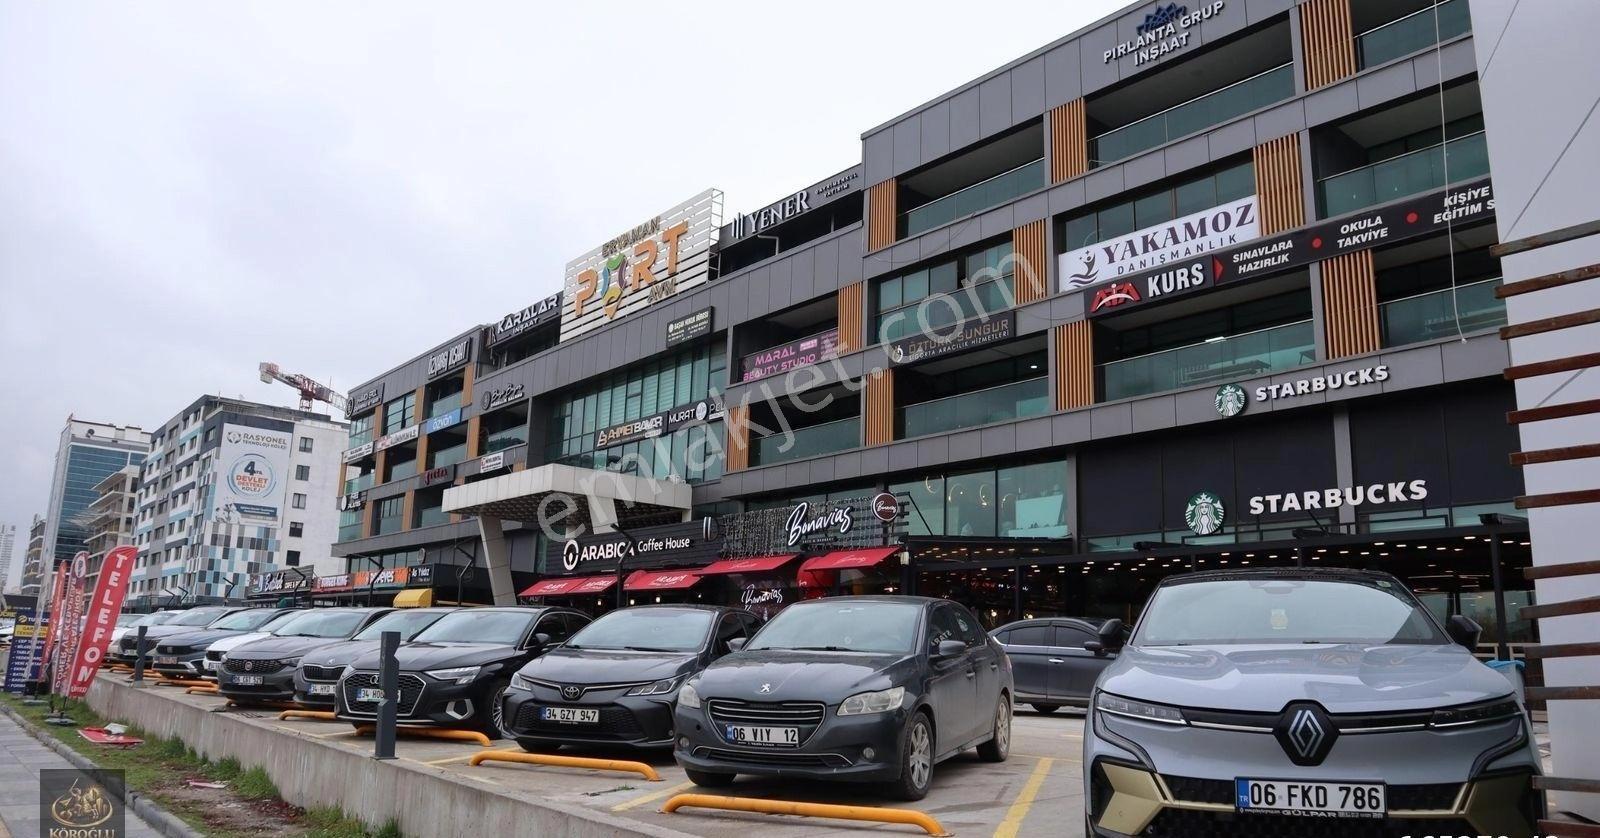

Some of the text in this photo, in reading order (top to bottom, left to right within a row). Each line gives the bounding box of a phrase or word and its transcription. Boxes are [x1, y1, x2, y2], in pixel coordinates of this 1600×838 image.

[1103, 1, 1224, 64] PIRLANTA GRUP
[1134, 31, 1190, 66] İNŞAAT
[1443, 184, 1491, 208] KİŞİYE
[749, 191, 809, 233] YENER
[1433, 203, 1483, 226] EĞİTİM
[602, 216, 661, 258] ERYAMAN
[1102, 202, 1255, 265] YAKAMOZ
[1336, 226, 1389, 249] TAKVİYE
[1340, 215, 1383, 235] OKULA
[1117, 234, 1237, 275] DANIŞMANLIK
[1232, 239, 1294, 264] SINAVLARA
[1238, 253, 1290, 275] HAZIRLIK
[575, 220, 689, 319] PORT
[1147, 263, 1205, 298] KURS
[646, 278, 678, 303] AVM
[497, 294, 559, 334] KARALAR
[908, 319, 1009, 354] ÖZTÜRK SUNGUR
[938, 341, 969, 354] ARACILIK
[971, 330, 1009, 346] HİZMETLERİ
[743, 353, 816, 383] BEAUTY STUDIO
[754, 346, 796, 366] MARAL
[1255, 365, 1390, 402] STARBUCKS
[668, 408, 695, 425] MURAT
[243, 432, 287, 445] RASYONEL
[236, 475, 269, 484] DEVLET
[244, 461, 256, 476] 4
[1250, 479, 1428, 515] STARBUCKS
[786, 502, 852, 546] Bonavias
[637, 538, 664, 553] Coffee
[665, 537, 690, 550] House
[77, 553, 128, 682] TELEFON
[361, 689, 369, 698] 34
[546, 708, 597, 721] 34 GZY 947
[733, 728, 797, 742] 06 VIY 12
[1250, 782, 1381, 810] 06 FKD 786
[1281, 809, 1337, 818] GÜLPAR
